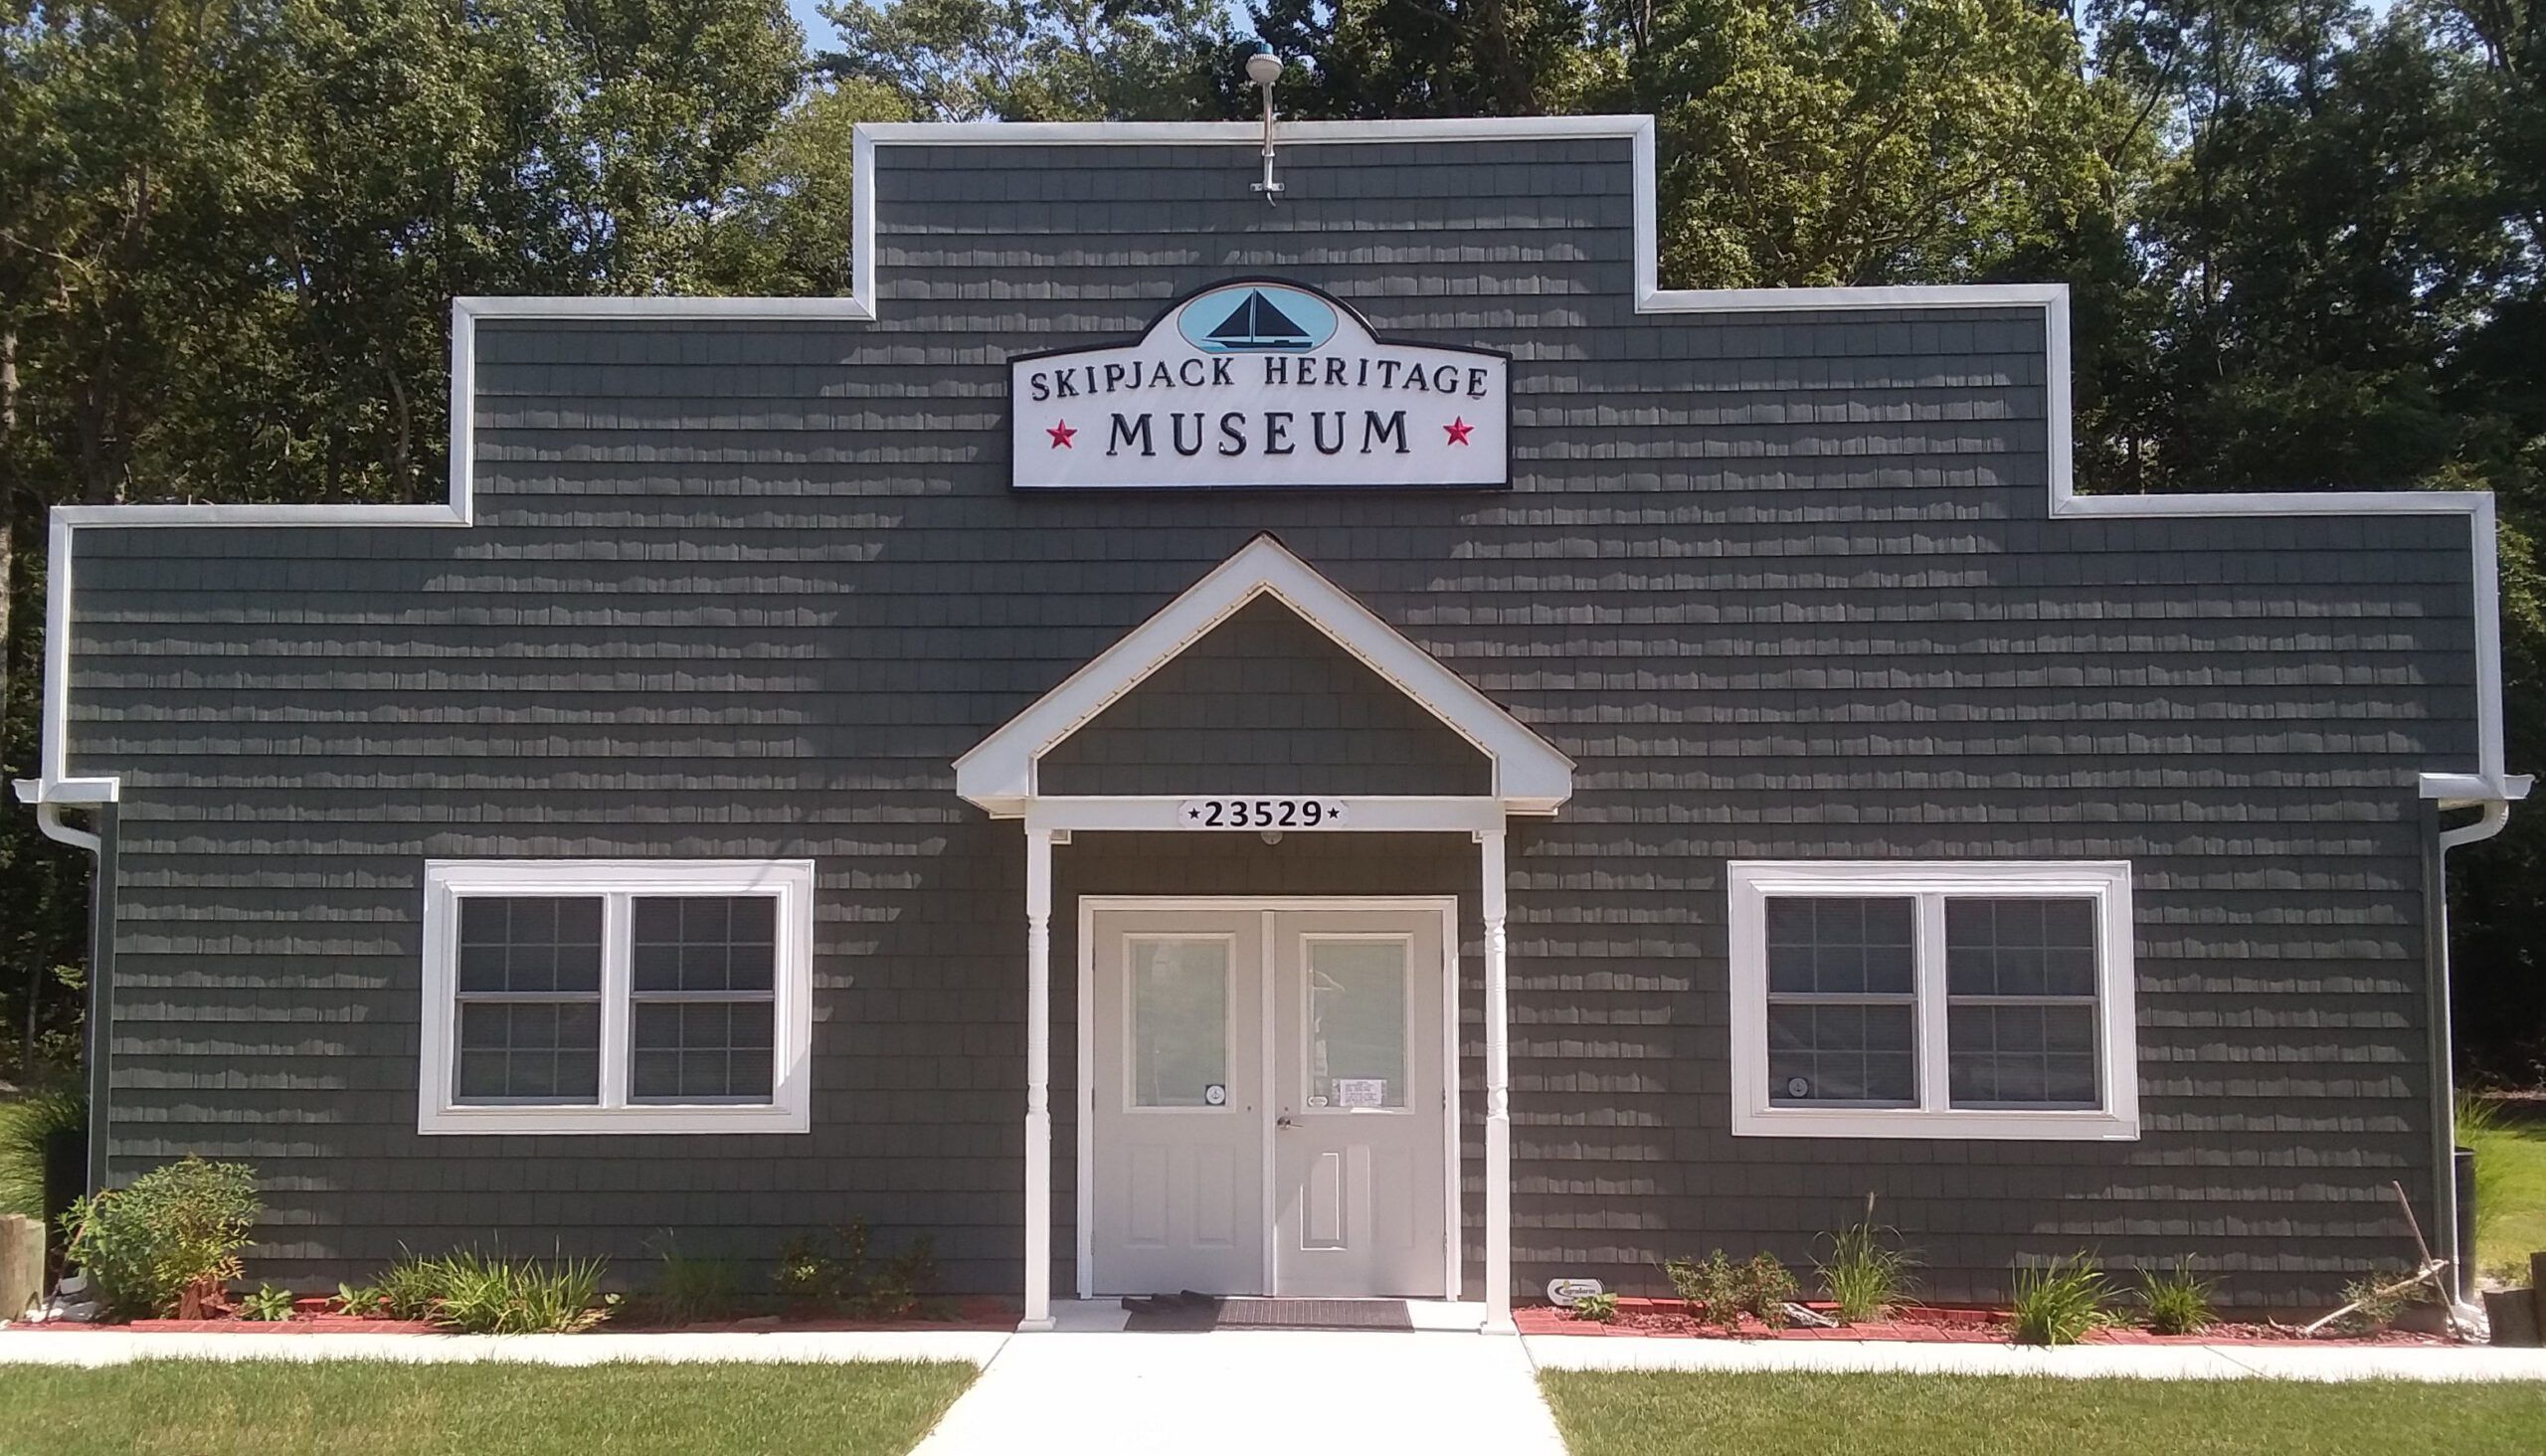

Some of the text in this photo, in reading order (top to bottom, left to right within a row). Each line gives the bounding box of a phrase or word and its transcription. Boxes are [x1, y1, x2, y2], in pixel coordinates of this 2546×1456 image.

[1030, 356, 1489, 402] SKIPJACK HERITAGE
[1105, 410, 1411, 456] MUSEUM
[1204, 801, 1322, 827] 23529
